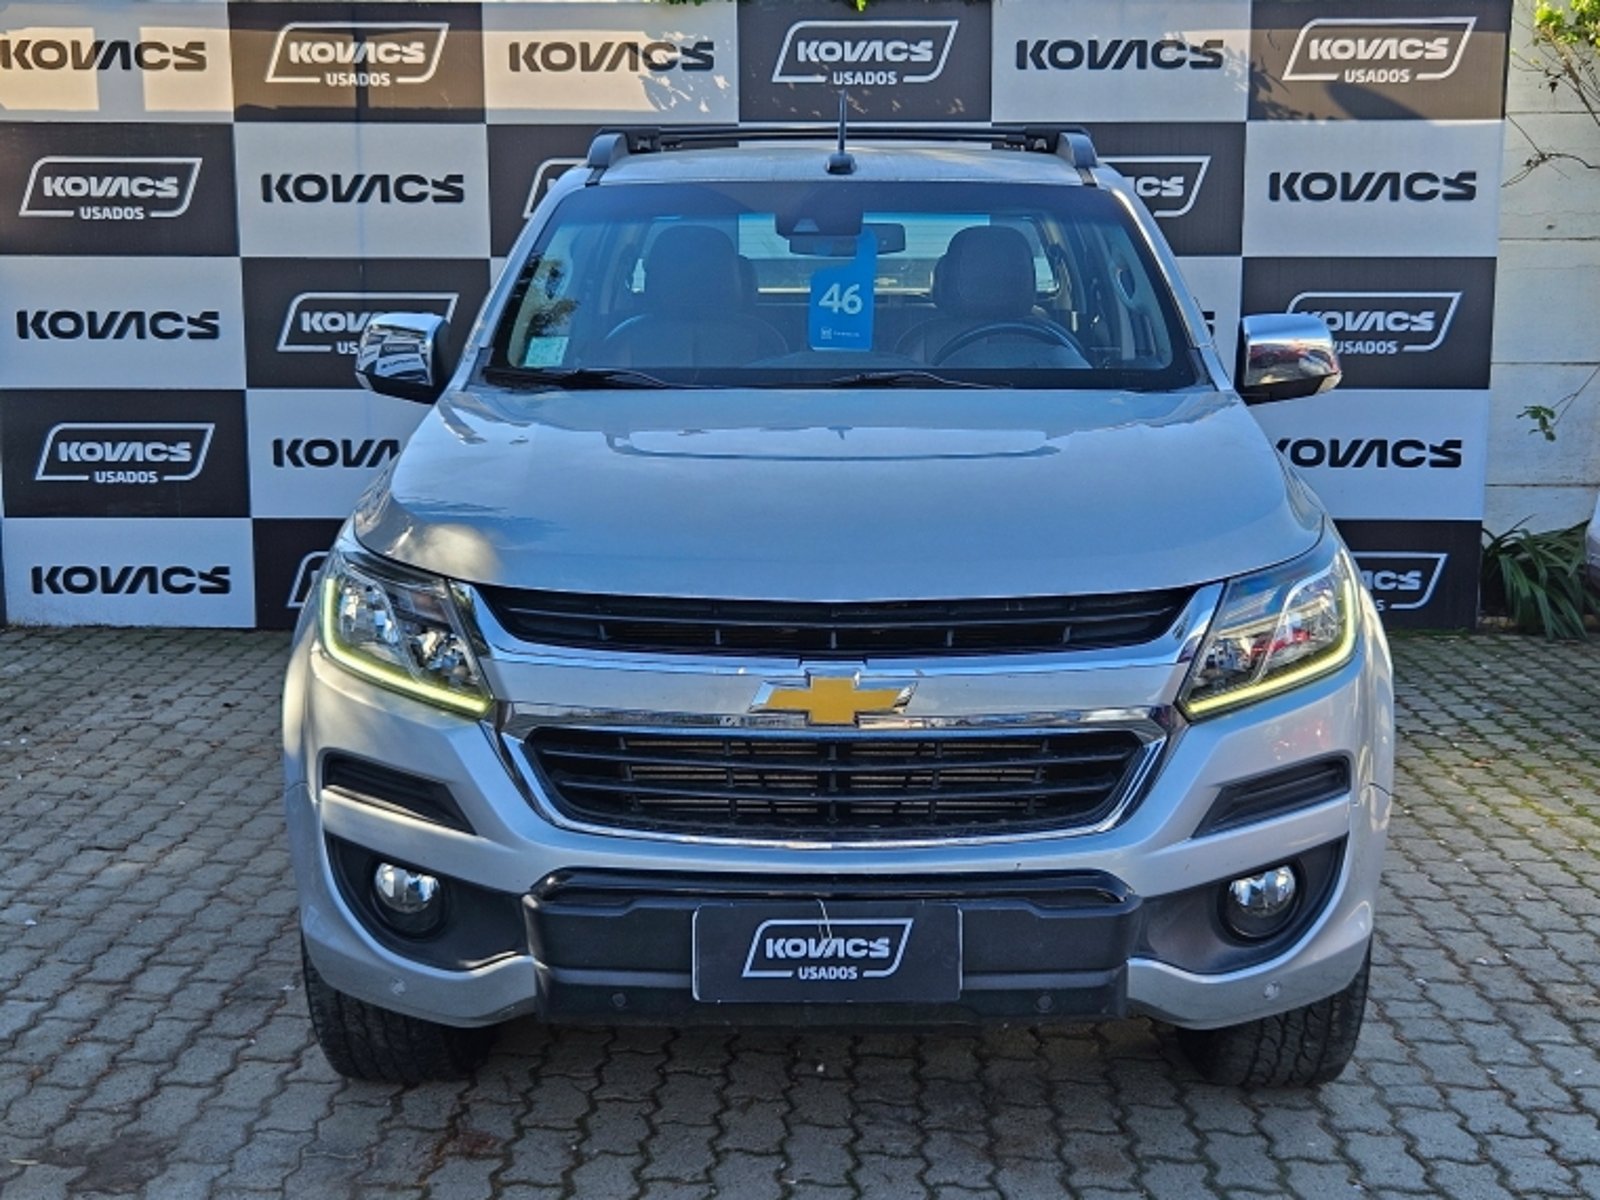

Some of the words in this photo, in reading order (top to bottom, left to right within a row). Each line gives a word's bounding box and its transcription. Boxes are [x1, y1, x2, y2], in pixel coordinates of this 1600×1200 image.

[0, 40, 206, 71] KOVACS
[289, 41, 426, 64] KOVACS
[508, 41, 714, 72] KOVACS
[797, 41, 933, 62] KOVACS
[1016, 39, 1223, 70] KOVACS
[1309, 37, 1449, 60] KOVACS
[325, 72, 391, 87] USADOS
[833, 71, 898, 85] USADOS
[1344, 69, 1411, 83] USADOS
[43, 176, 179, 197] KOVACS
[261, 173, 464, 203] KOVACS
[1269, 171, 1477, 201] KOVACS
[79, 206, 145, 220] USADOS
[818, 283, 863, 314] 46
[16, 310, 219, 340] KOVACS
[301, 311, 374, 332] KOV
[1302, 311, 1435, 332] OVACS
[58, 441, 192, 462] KOVACS
[273, 438, 399, 468] KOVA
[94, 471, 159, 484] USADOS
[32, 565, 230, 595] KOVACS
[765, 937, 890, 959] KOVACS
[798, 966, 858, 980] USADOS
